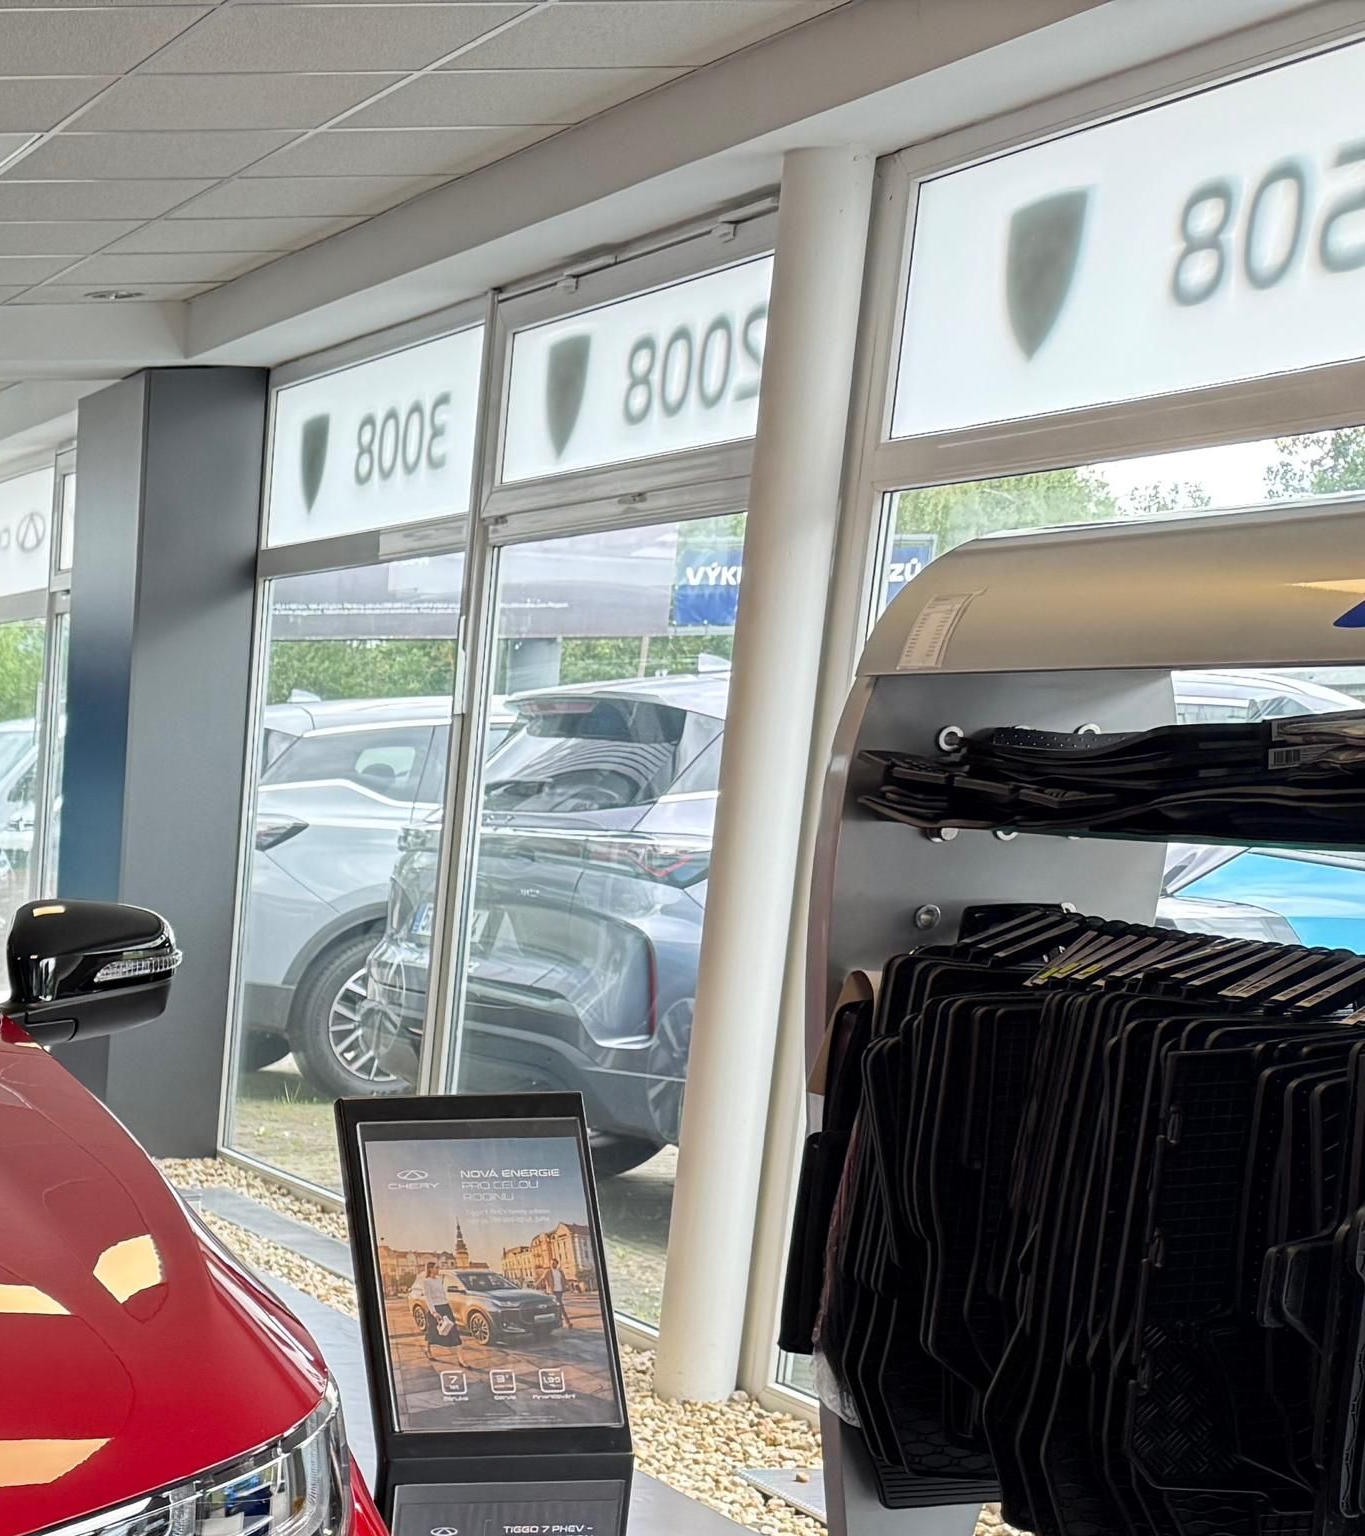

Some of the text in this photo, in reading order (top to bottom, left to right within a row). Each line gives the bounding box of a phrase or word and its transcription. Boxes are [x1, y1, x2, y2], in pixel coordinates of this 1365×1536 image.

[686, 558, 922, 585] VÝK ZŮ
[460, 1168, 560, 1178] NOVÁ ENERGIE
[388, 1182, 439, 1190] CHERY
[462, 1180, 539, 1190] PRO CELOU
[463, 1193, 515, 1201] RODINU
[448, 1375, 458, 1384] 7
[541, 1525, 550, 1533] 7
